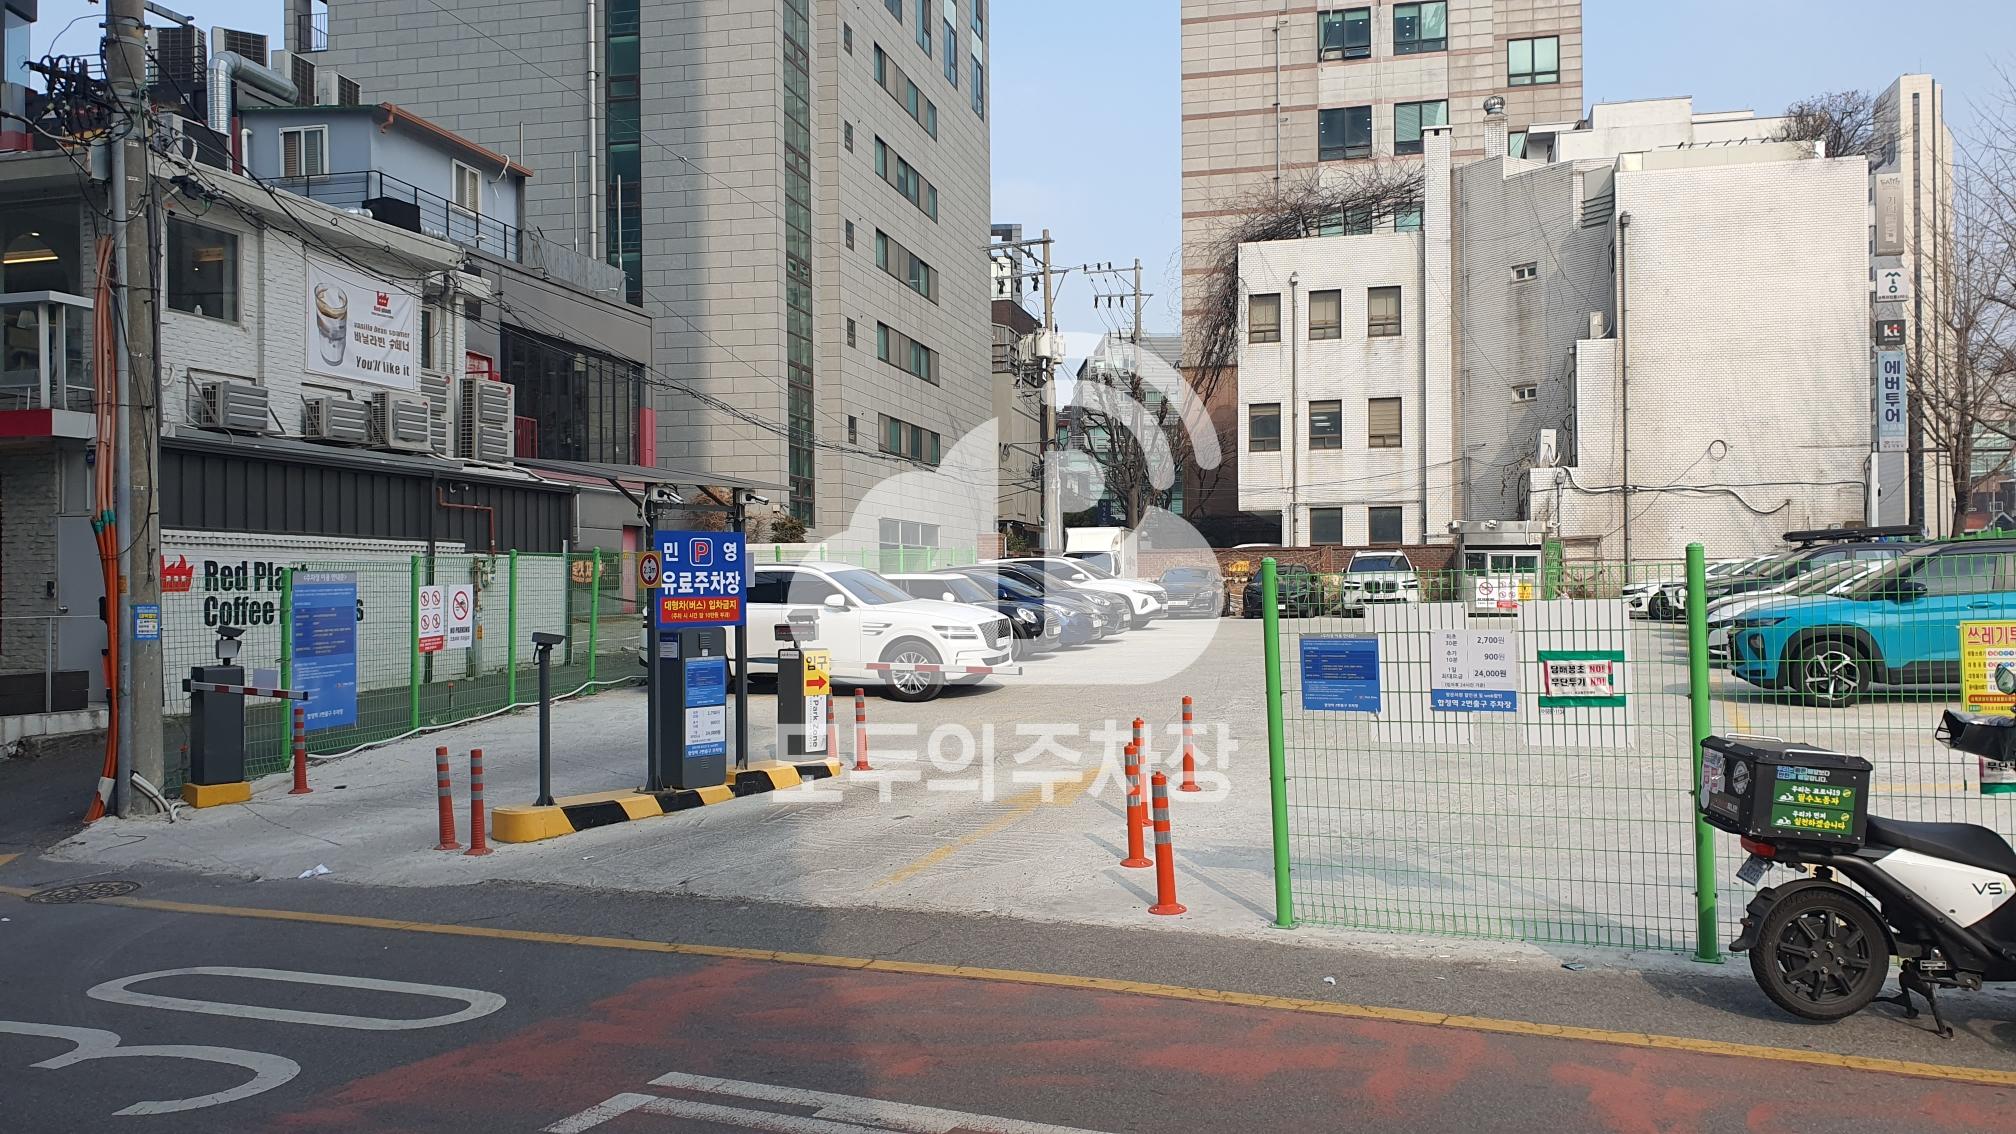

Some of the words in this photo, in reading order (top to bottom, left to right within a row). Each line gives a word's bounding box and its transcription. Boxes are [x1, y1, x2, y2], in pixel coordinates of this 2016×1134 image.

[356, 355, 381, 371] You'll
[382, 361, 401, 374] like
[403, 364, 410, 377] it
[1884, 360, 1901, 423] 에버투어
[664, 541, 679, 562] 민
[694, 541, 709, 563] P
[723, 541, 737, 562] 영
[204, 560, 249, 592] Red
[253, 560, 308, 592] Pla
[643, 566, 656, 574] 2.3m
[661, 570, 741, 596] 유료주차장
[664, 599, 707, 611] 대형차(버스)
[708, 599, 738, 610] 입차금지
[204, 596, 275, 627] Coffee
[1477, 636, 1505, 645] 2,700원
[806, 655, 828, 671] 입구
[1484, 653, 1506, 661] 900원
[1474, 669, 1507, 678] 24,000원
[1550, 665, 1585, 674] 담배꽁초
[1589, 664, 1606, 674] NO!
[1551, 677, 1586, 687] 무단투기
[1590, 677, 1606, 686] NO!
[1437, 699, 1459, 708] 합정역
[1461, 699, 1488, 708] 2번출구
[1489, 700, 1512, 709] 주차장
[1792, 785, 1811, 794] 우리는
[1812, 787, 1840, 797] 코로나19
[1798, 793, 1840, 805] 필수노동자
[1792, 810, 1812, 818] 우리가
[1813, 811, 1827, 820] 먼저
[1794, 817, 1846, 830] 실천하겠습니다
